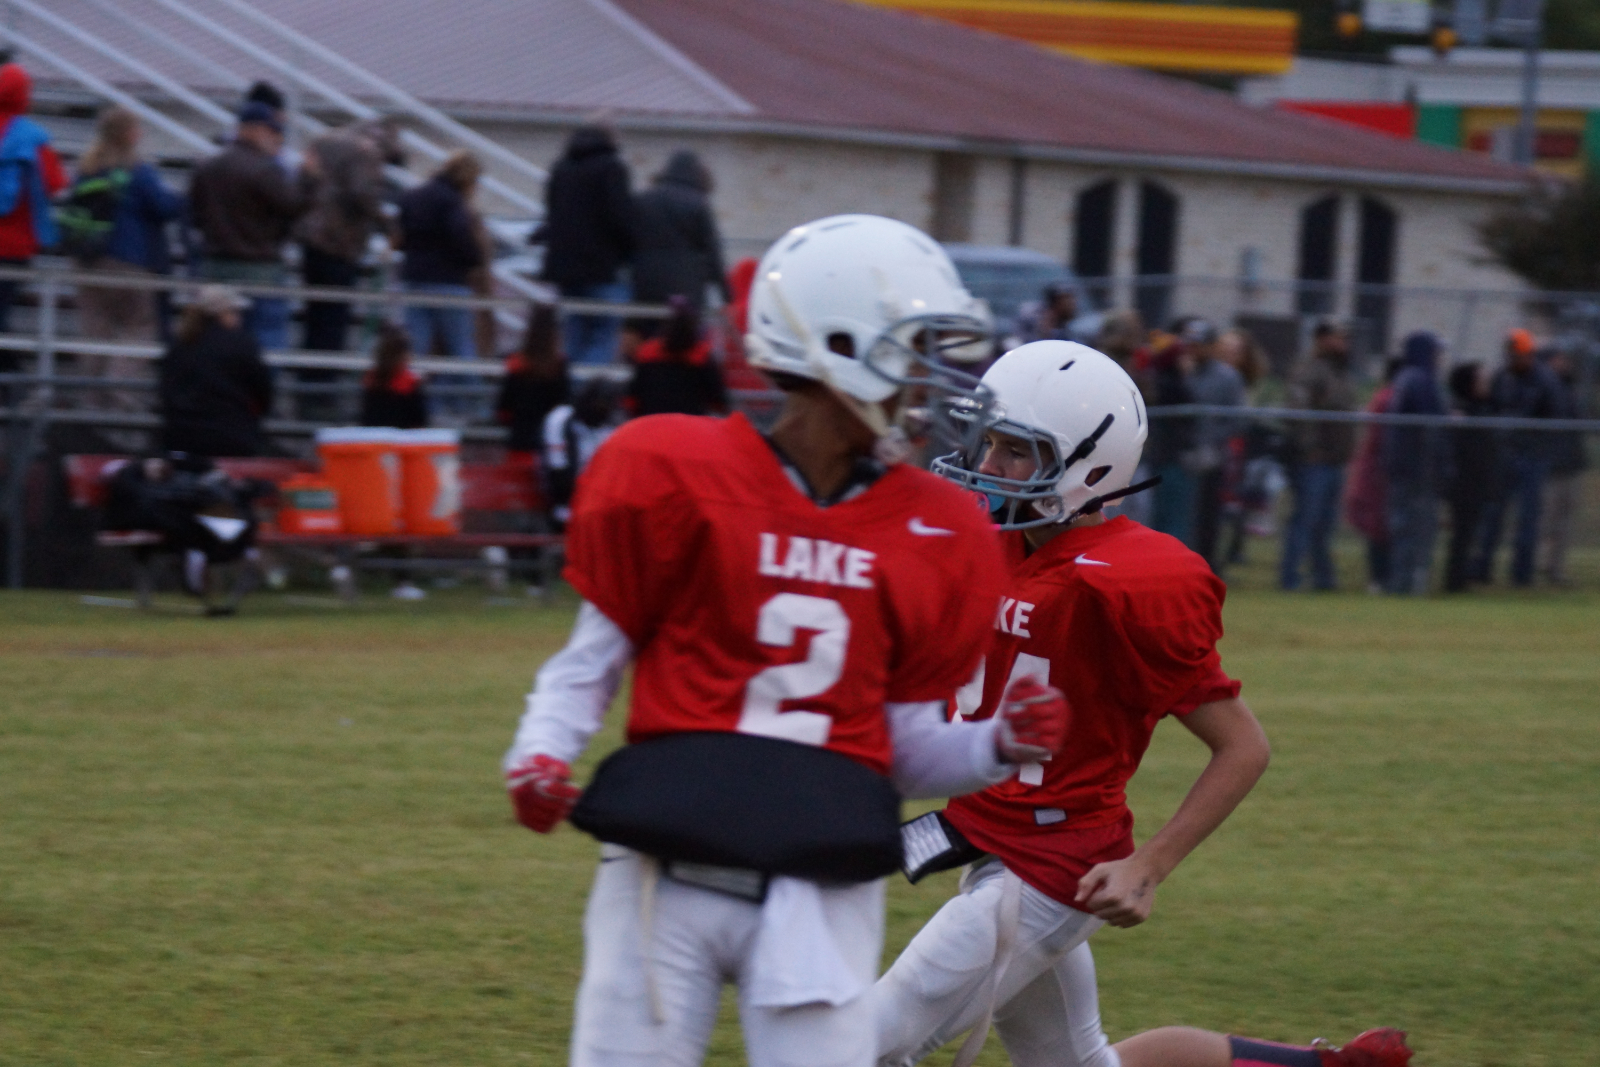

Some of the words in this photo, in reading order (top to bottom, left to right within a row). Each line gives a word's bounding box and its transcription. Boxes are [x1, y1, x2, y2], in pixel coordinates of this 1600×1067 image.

[758, 532, 877, 589] LAKE
[994, 596, 1035, 639] KE
[737, 592, 851, 746] 2
